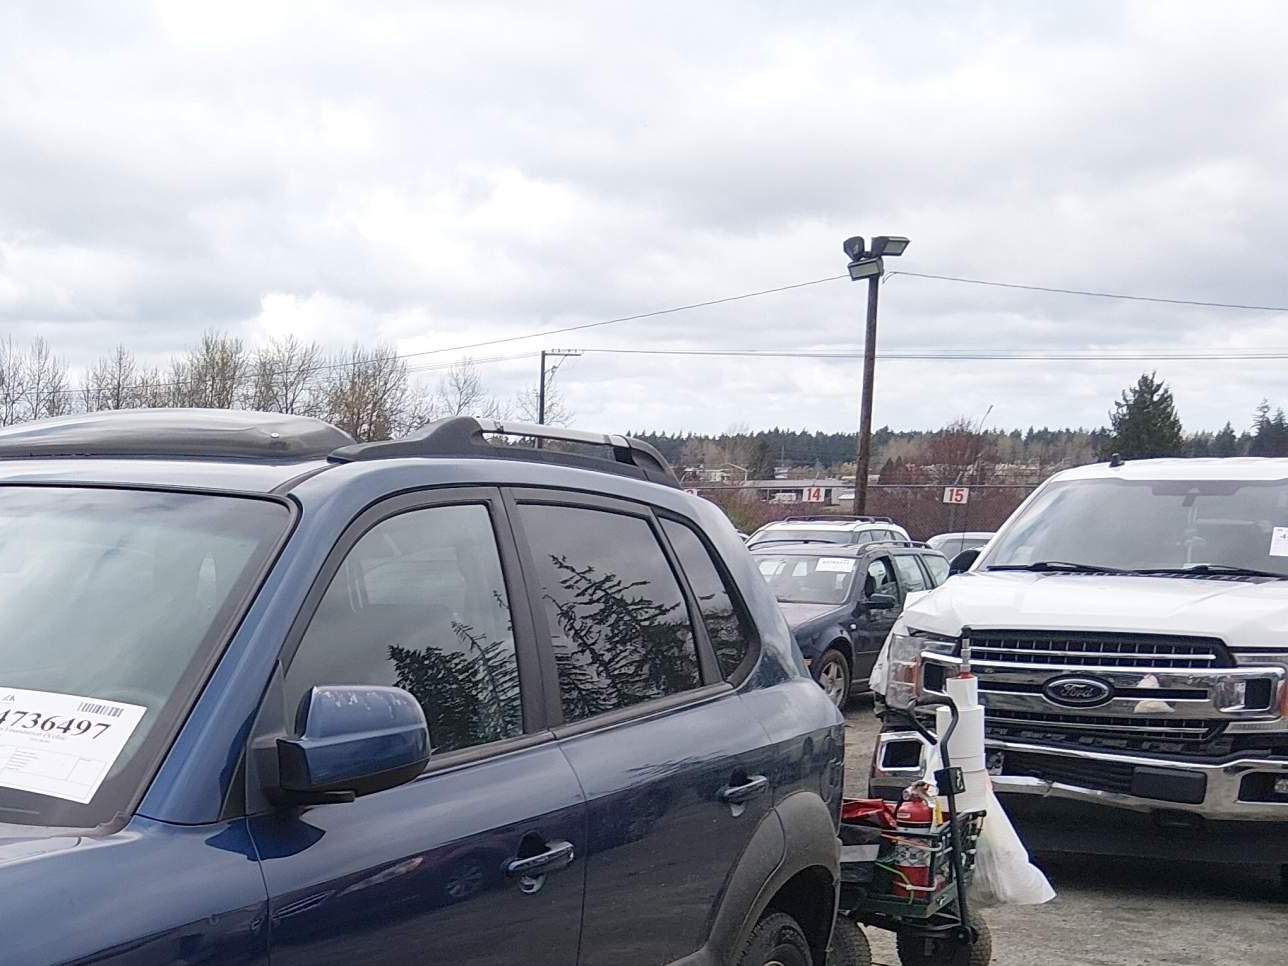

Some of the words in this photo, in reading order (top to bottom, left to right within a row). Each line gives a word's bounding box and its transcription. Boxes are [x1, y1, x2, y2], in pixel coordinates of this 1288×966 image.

[807, 487, 821, 500] 14
[948, 488, 964, 503] 15
[1062, 683, 1094, 698] Ford
